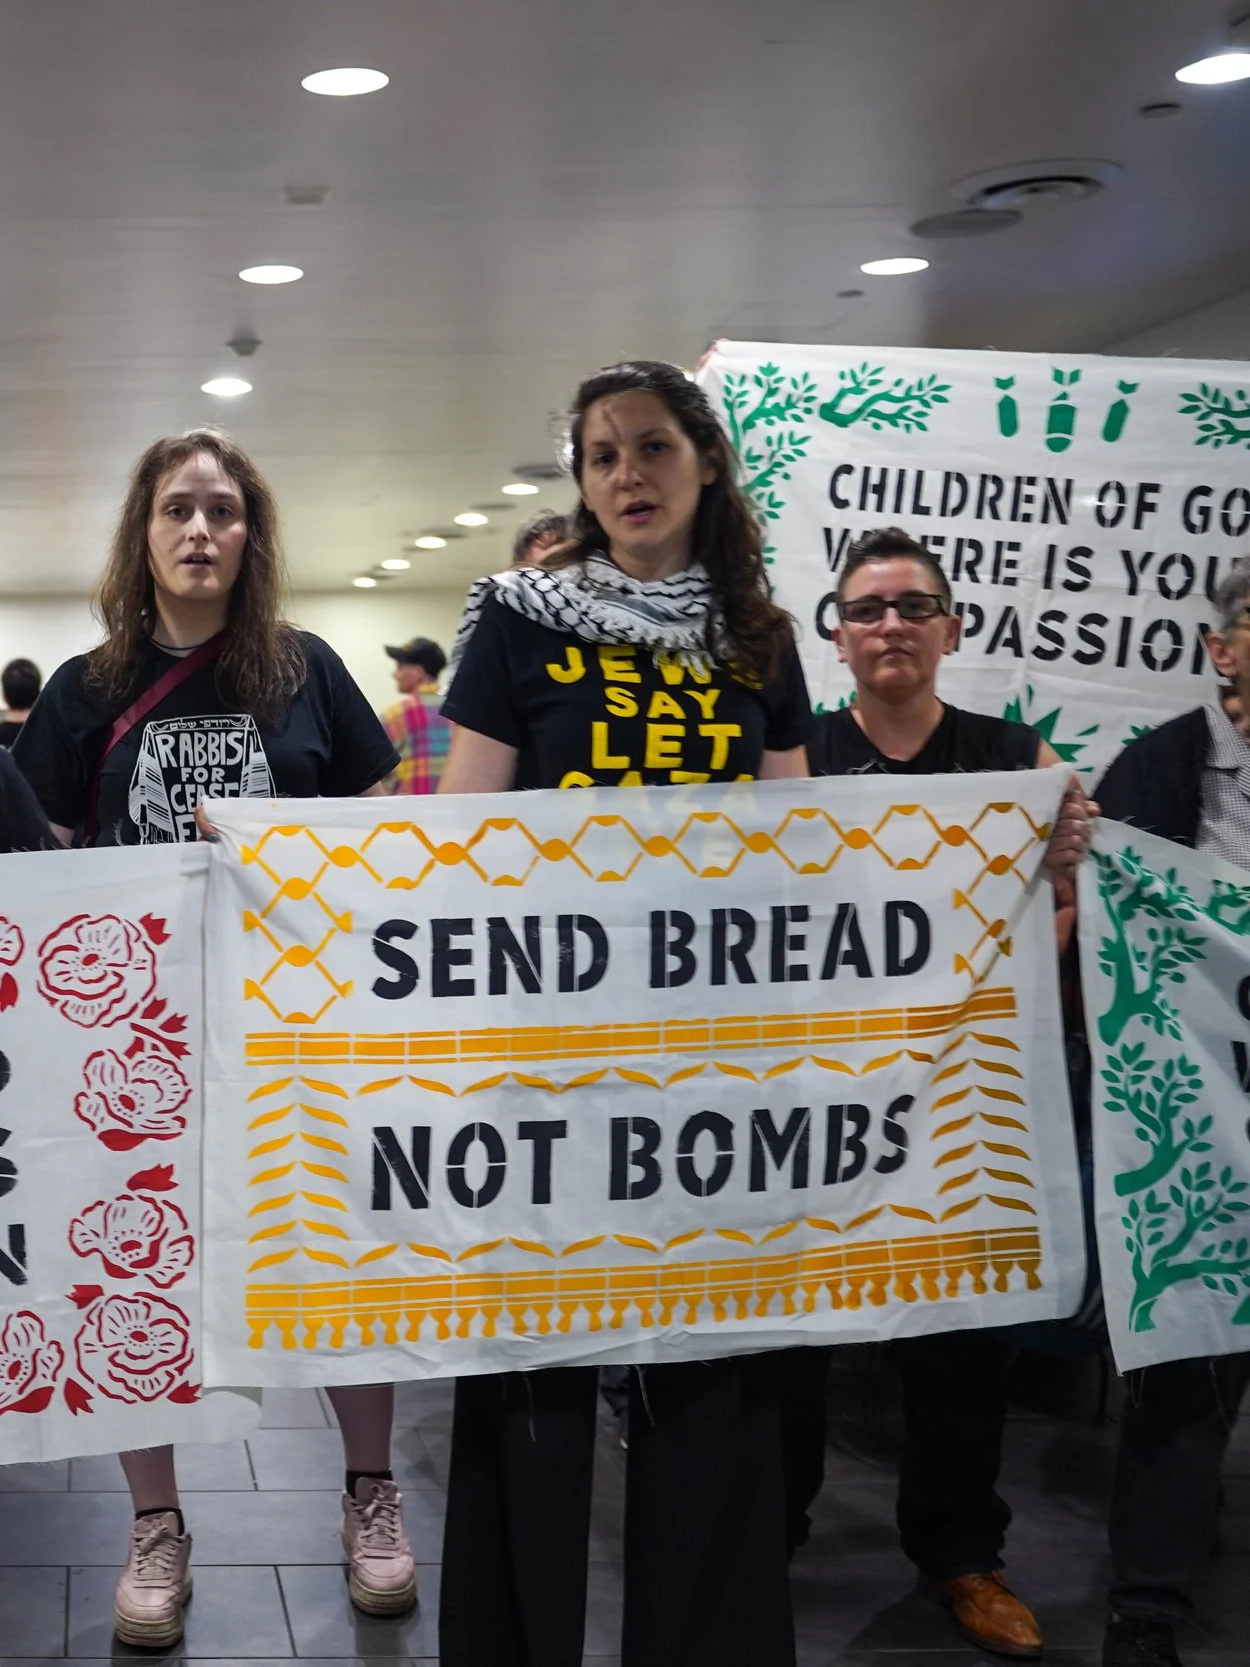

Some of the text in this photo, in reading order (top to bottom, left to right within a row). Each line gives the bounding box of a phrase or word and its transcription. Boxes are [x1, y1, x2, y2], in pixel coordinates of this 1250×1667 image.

[829, 463, 1250, 537] CHILDREN OF GO
[1044, 543, 1095, 593] IS
[546, 645, 763, 690] JEW
[604, 686, 721, 719] SAY
[154, 731, 245, 768] RABBIS
[591, 721, 742, 770] LET
[180, 767, 226, 782] FOR
[371, 900, 932, 1000] SEND BREAD
[370, 1094, 916, 1212] NOT BOMBS
